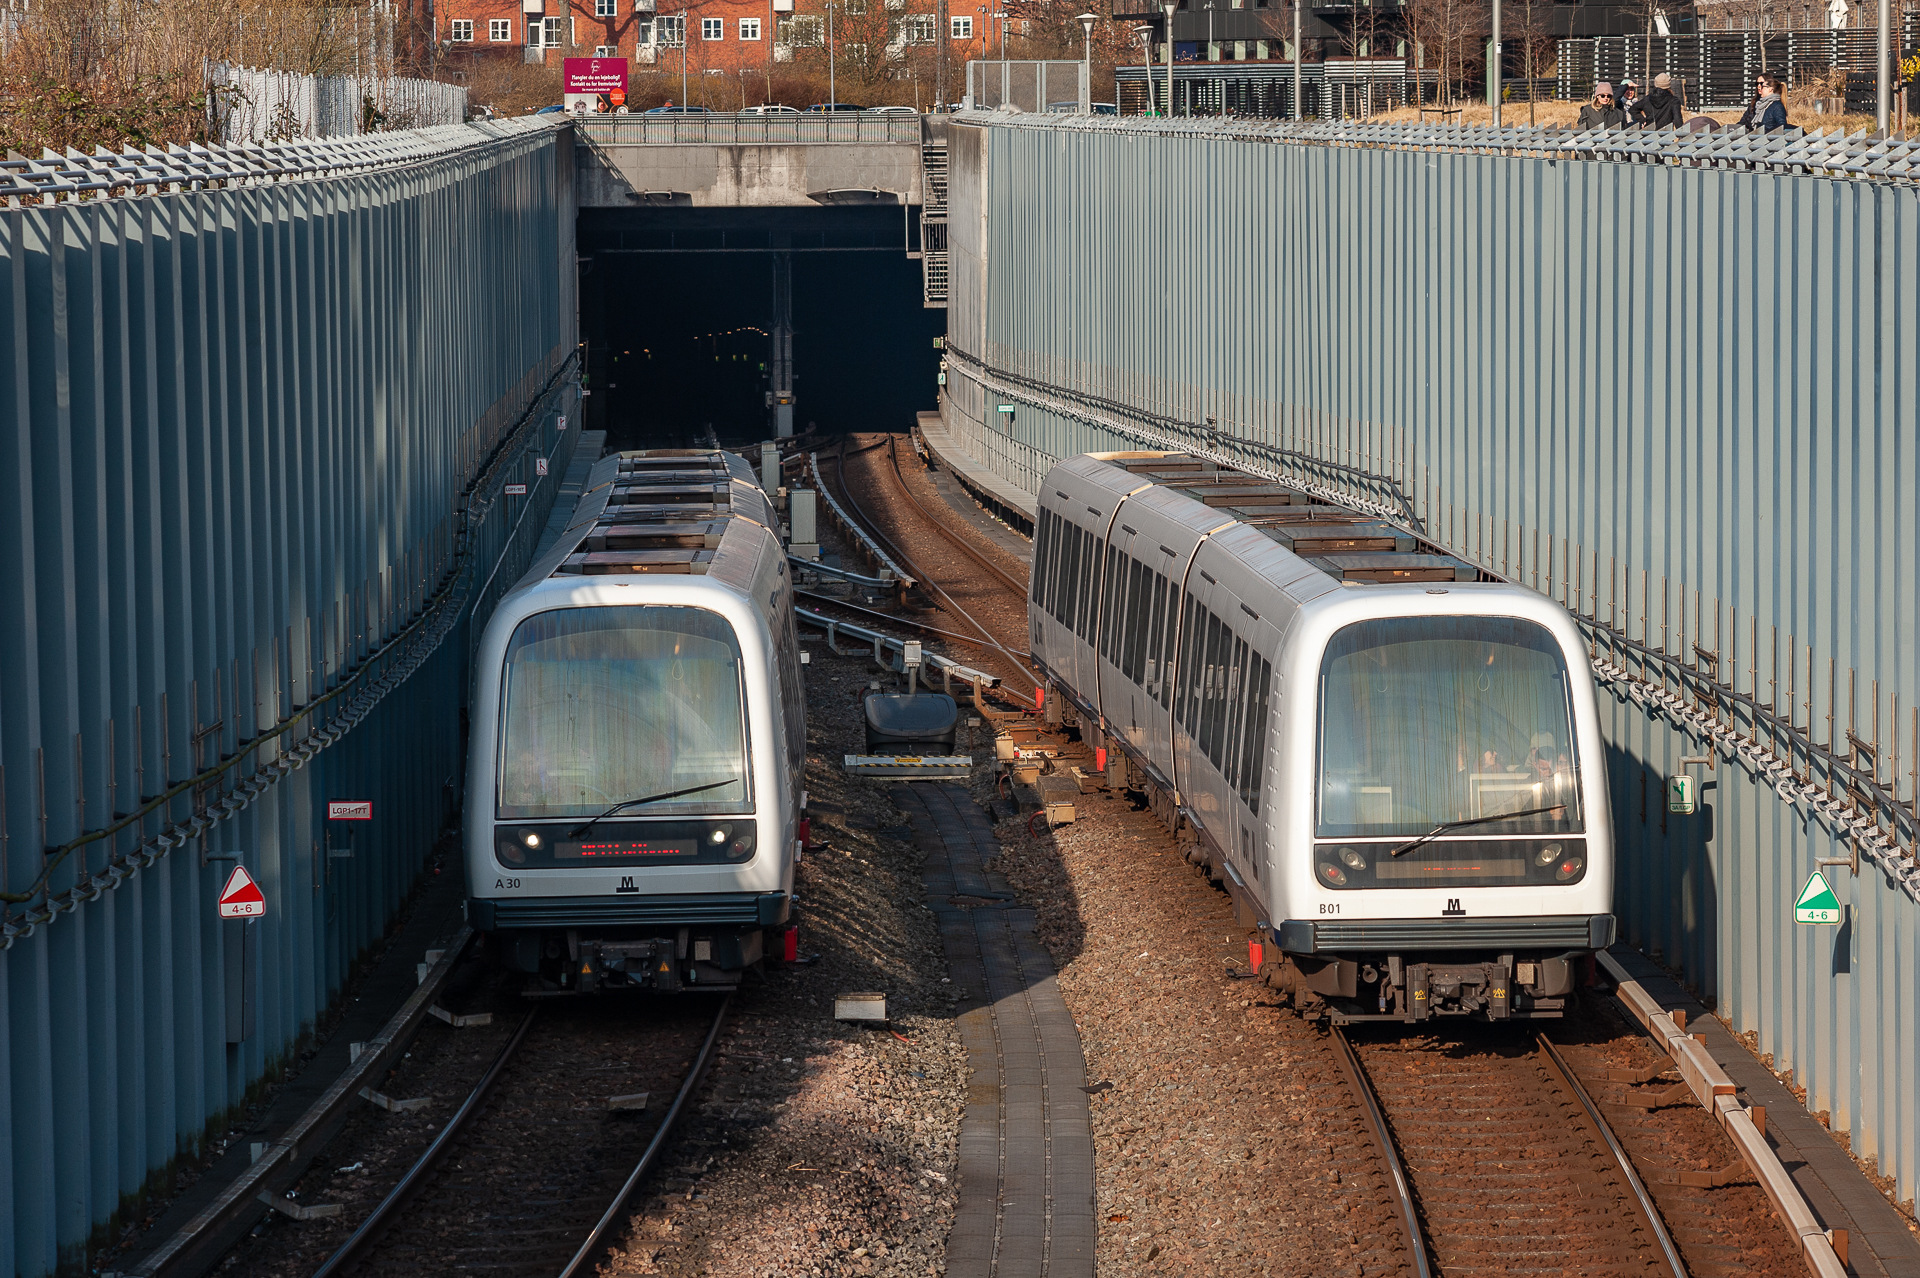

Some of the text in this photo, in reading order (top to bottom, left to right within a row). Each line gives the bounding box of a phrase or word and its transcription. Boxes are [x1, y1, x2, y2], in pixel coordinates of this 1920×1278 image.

[494, 878, 521, 889] A30
[232, 904, 253, 914] 4-6
[1319, 903, 1341, 914] B01
[1807, 910, 1828, 920] 4-6
